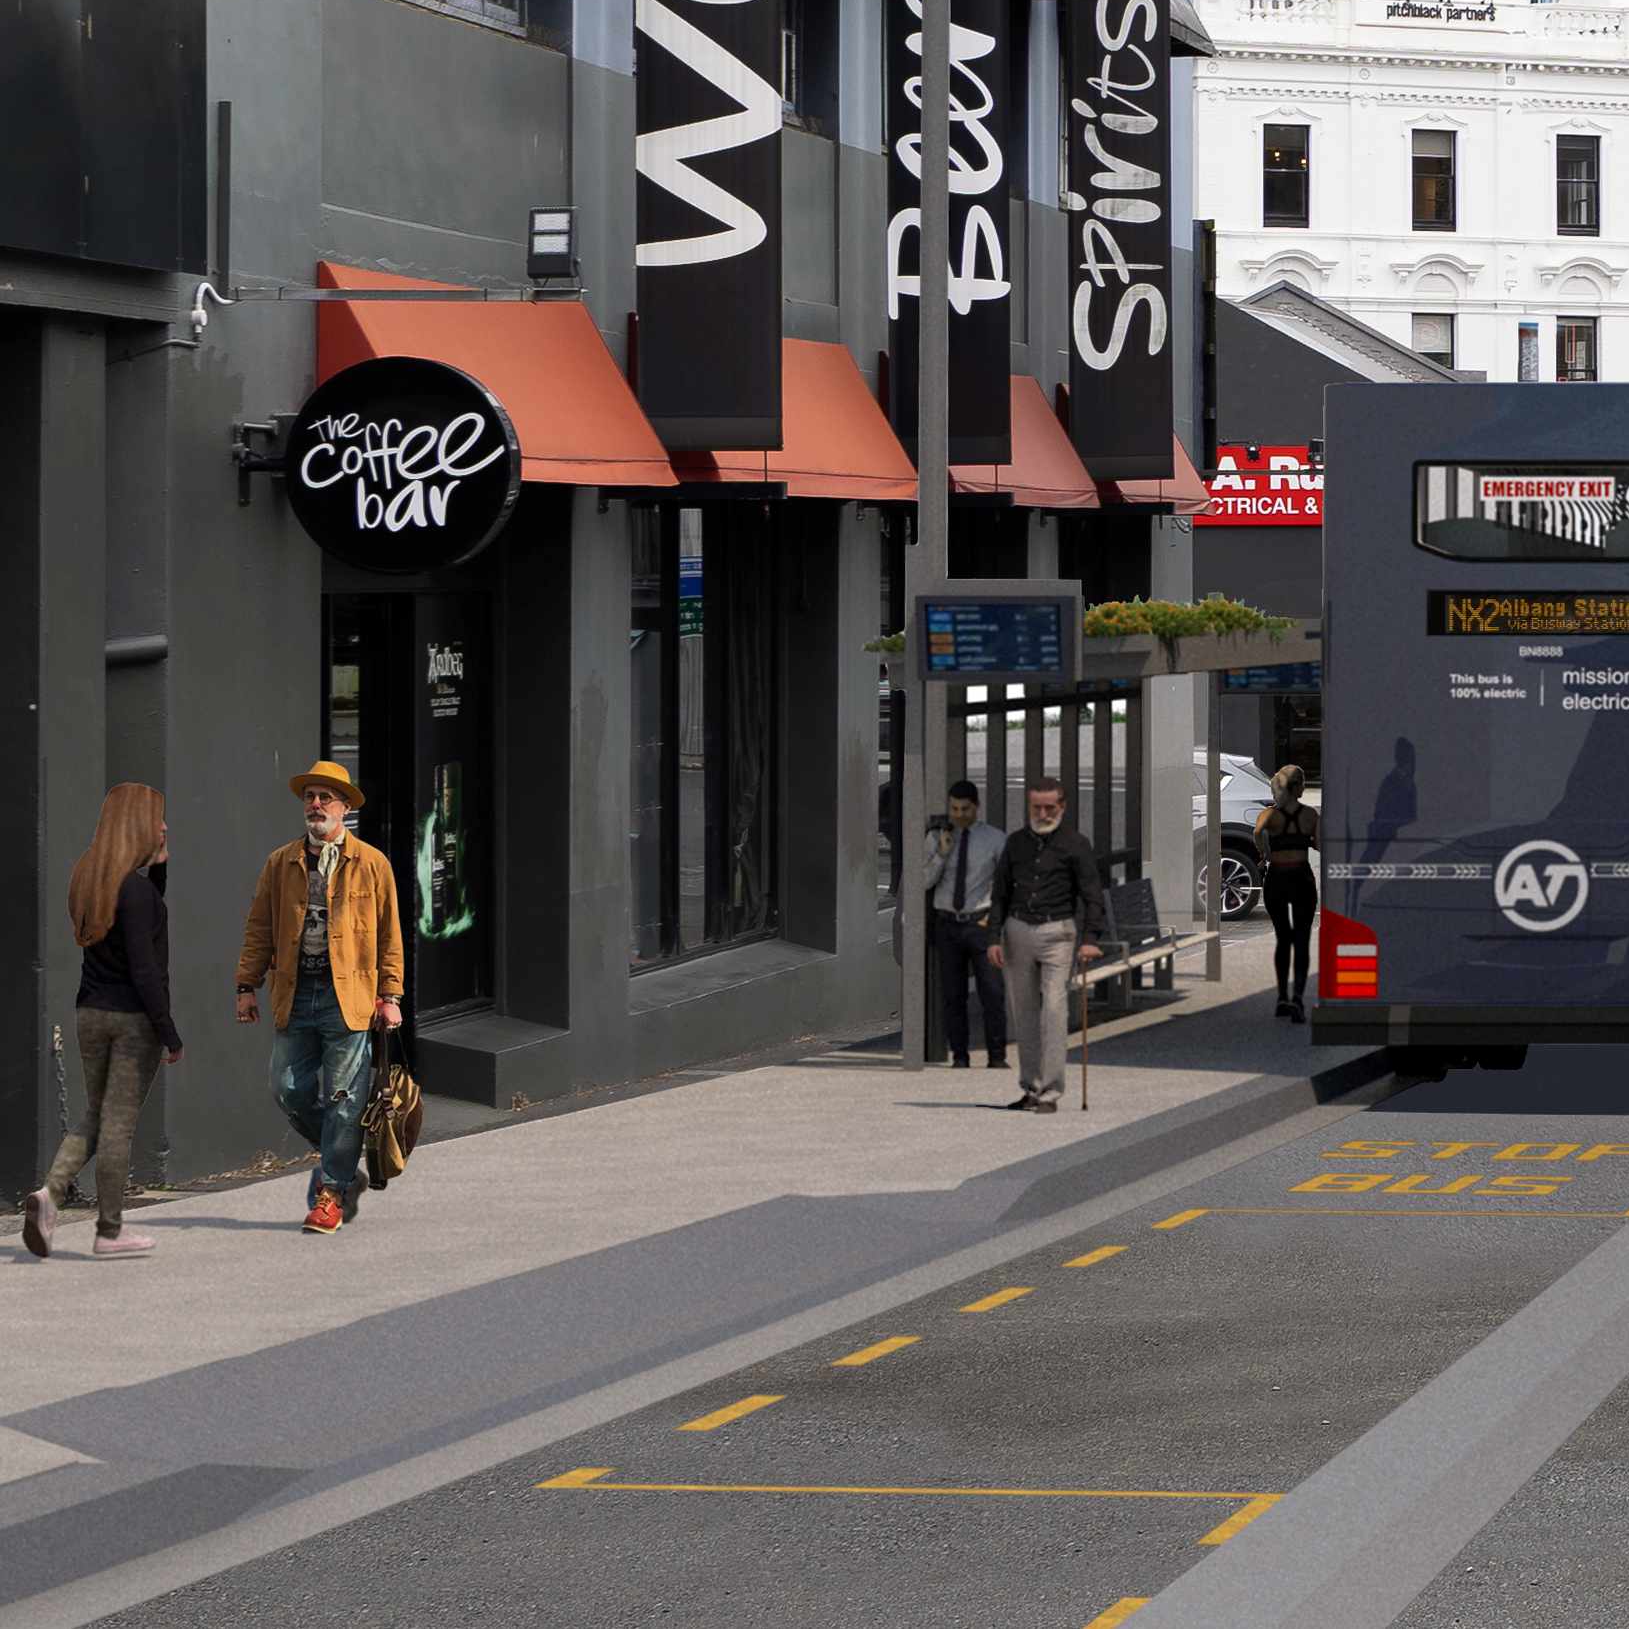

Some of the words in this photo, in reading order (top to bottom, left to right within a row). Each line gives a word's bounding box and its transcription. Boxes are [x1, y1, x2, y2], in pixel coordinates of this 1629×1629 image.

[1386, 1, 1443, 20] pitchblack
[1446, 4, 1496, 24] partners
[307, 412, 366, 443] The
[1483, 481, 1575, 498] EMERGENCY
[1579, 481, 1612, 498] EXIT
[356, 476, 462, 533] bar
[1304, 497, 1319, 515] &
[1449, 598, 1500, 632] NX2
[1500, 598, 1567, 621] Albany
[1531, 619, 1580, 631] Busway
[1450, 674, 1476, 684] This
[1478, 674, 1500, 684] bus
[1502, 674, 1513, 684] is
[1450, 688, 1481, 699] 100%
[1483, 688, 1527, 699] electric
[1287, 1173, 1574, 1196] BUS
